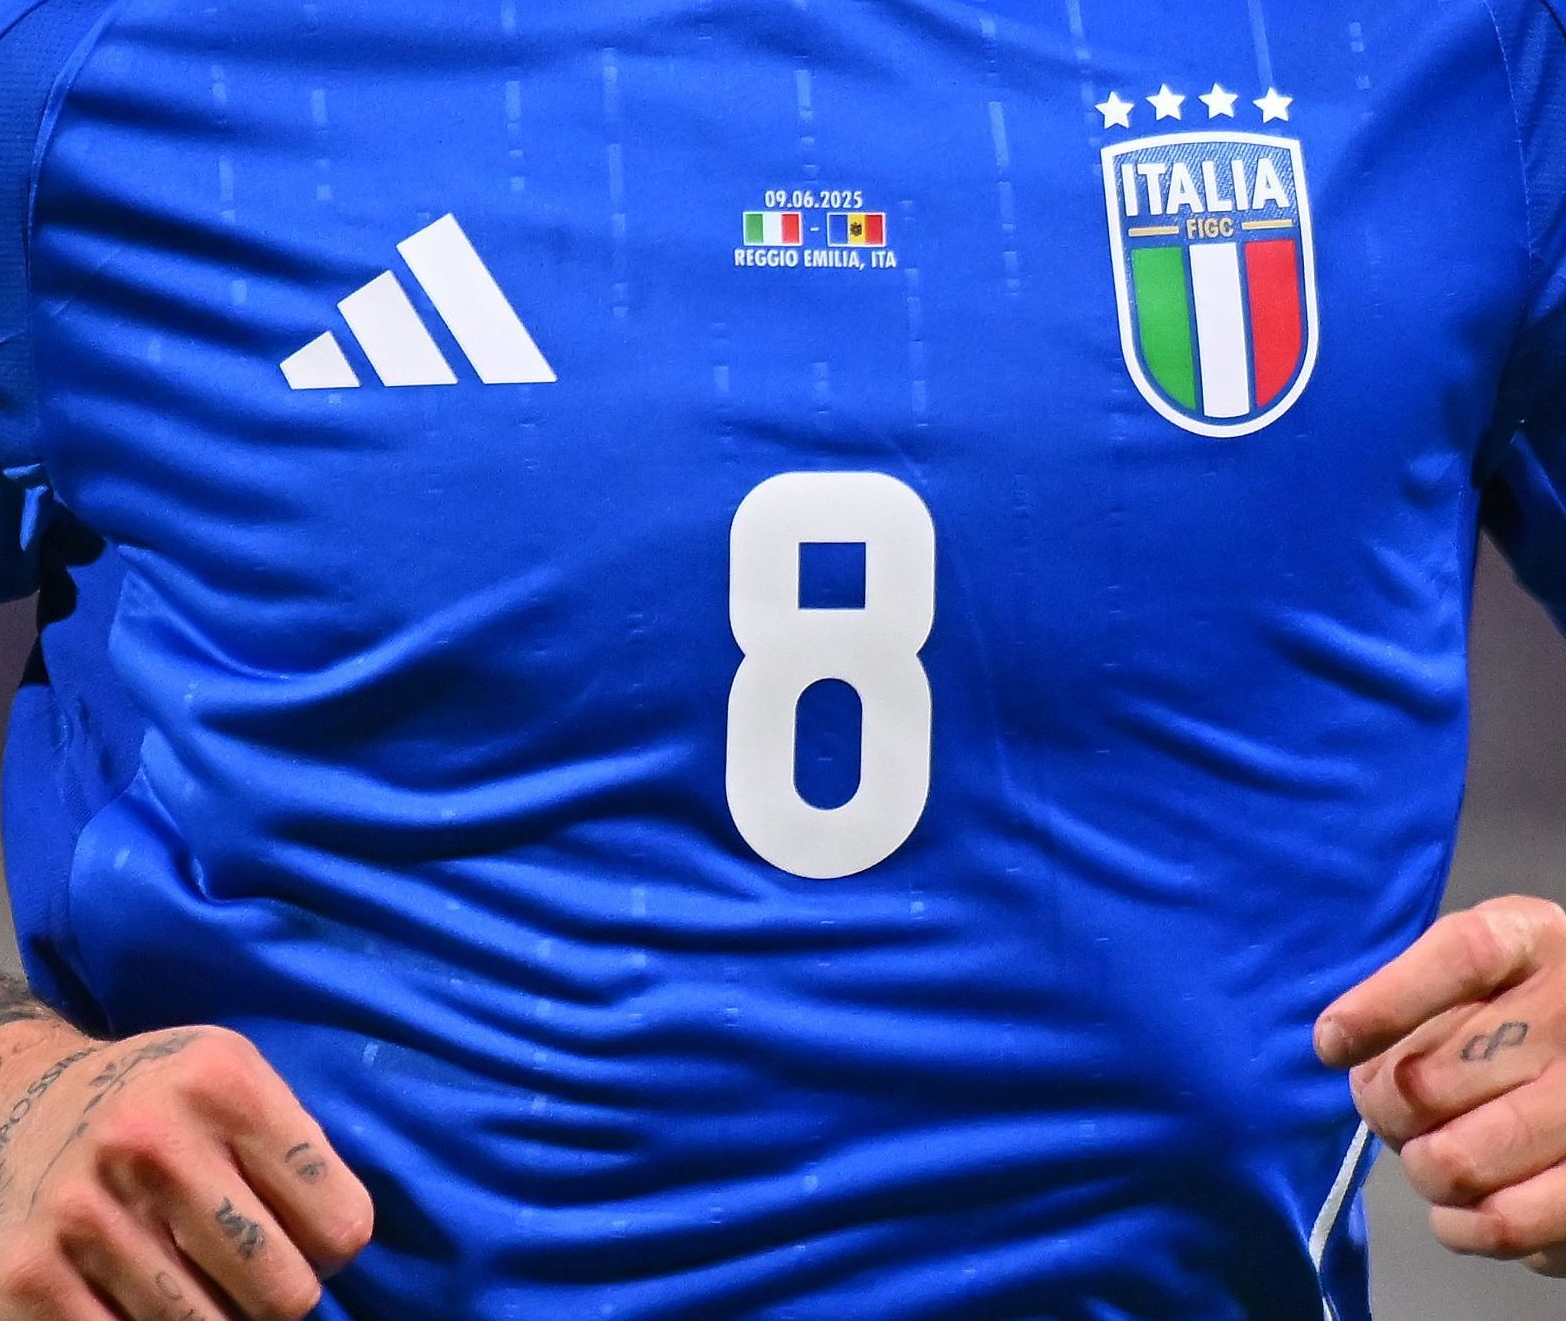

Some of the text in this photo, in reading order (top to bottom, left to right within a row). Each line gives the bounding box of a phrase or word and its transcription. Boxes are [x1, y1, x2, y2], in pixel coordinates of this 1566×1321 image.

[1120, 157, 1291, 217] ITALIA
[764, 190, 863, 209] 09.06.2025
[1186, 217, 1235, 240] FIGC
[734, 249, 897, 271] REGGIO EMILIA, ITA
[724, 470, 936, 880] 8
